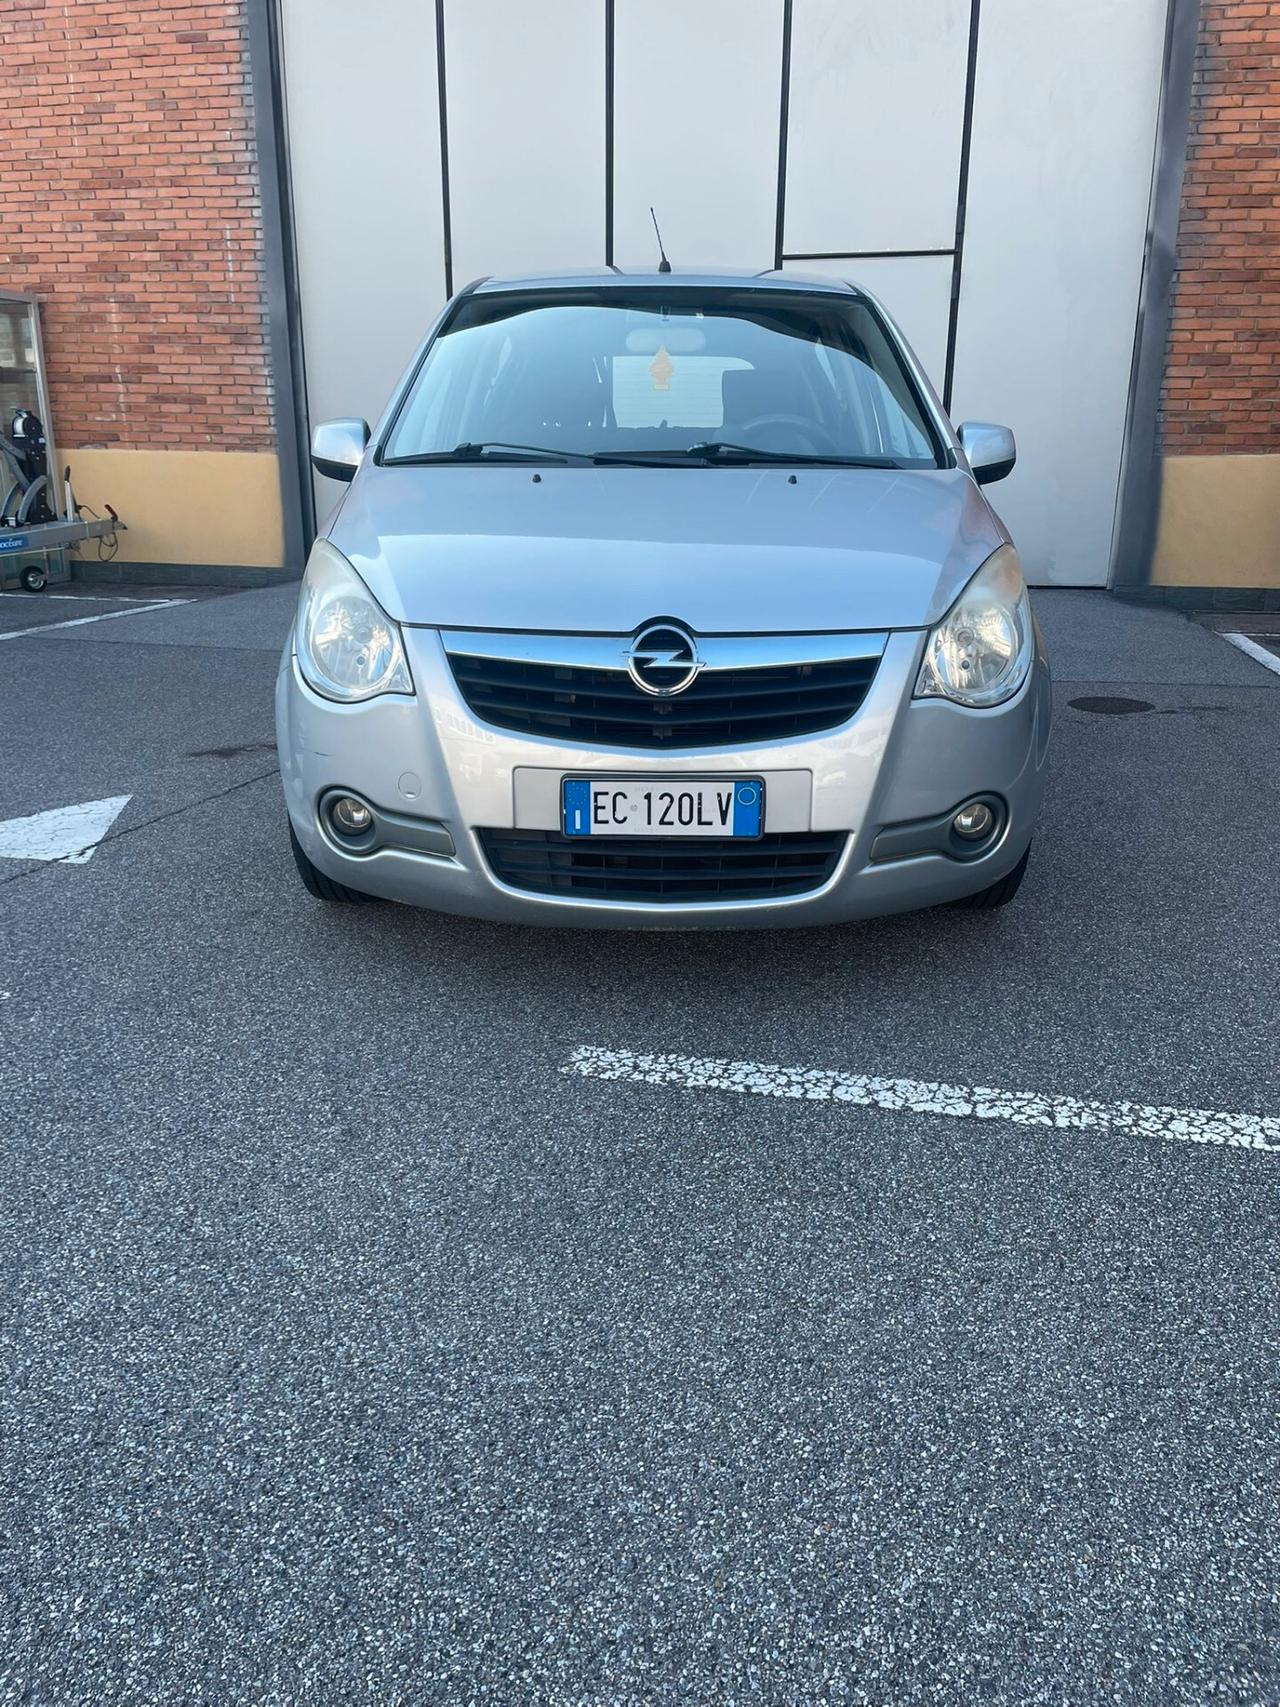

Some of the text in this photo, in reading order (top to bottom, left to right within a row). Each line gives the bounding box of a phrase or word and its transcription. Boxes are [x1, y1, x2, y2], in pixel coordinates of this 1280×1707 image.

[575, 809, 581, 830] I
[593, 791, 732, 826] EC 120LV
